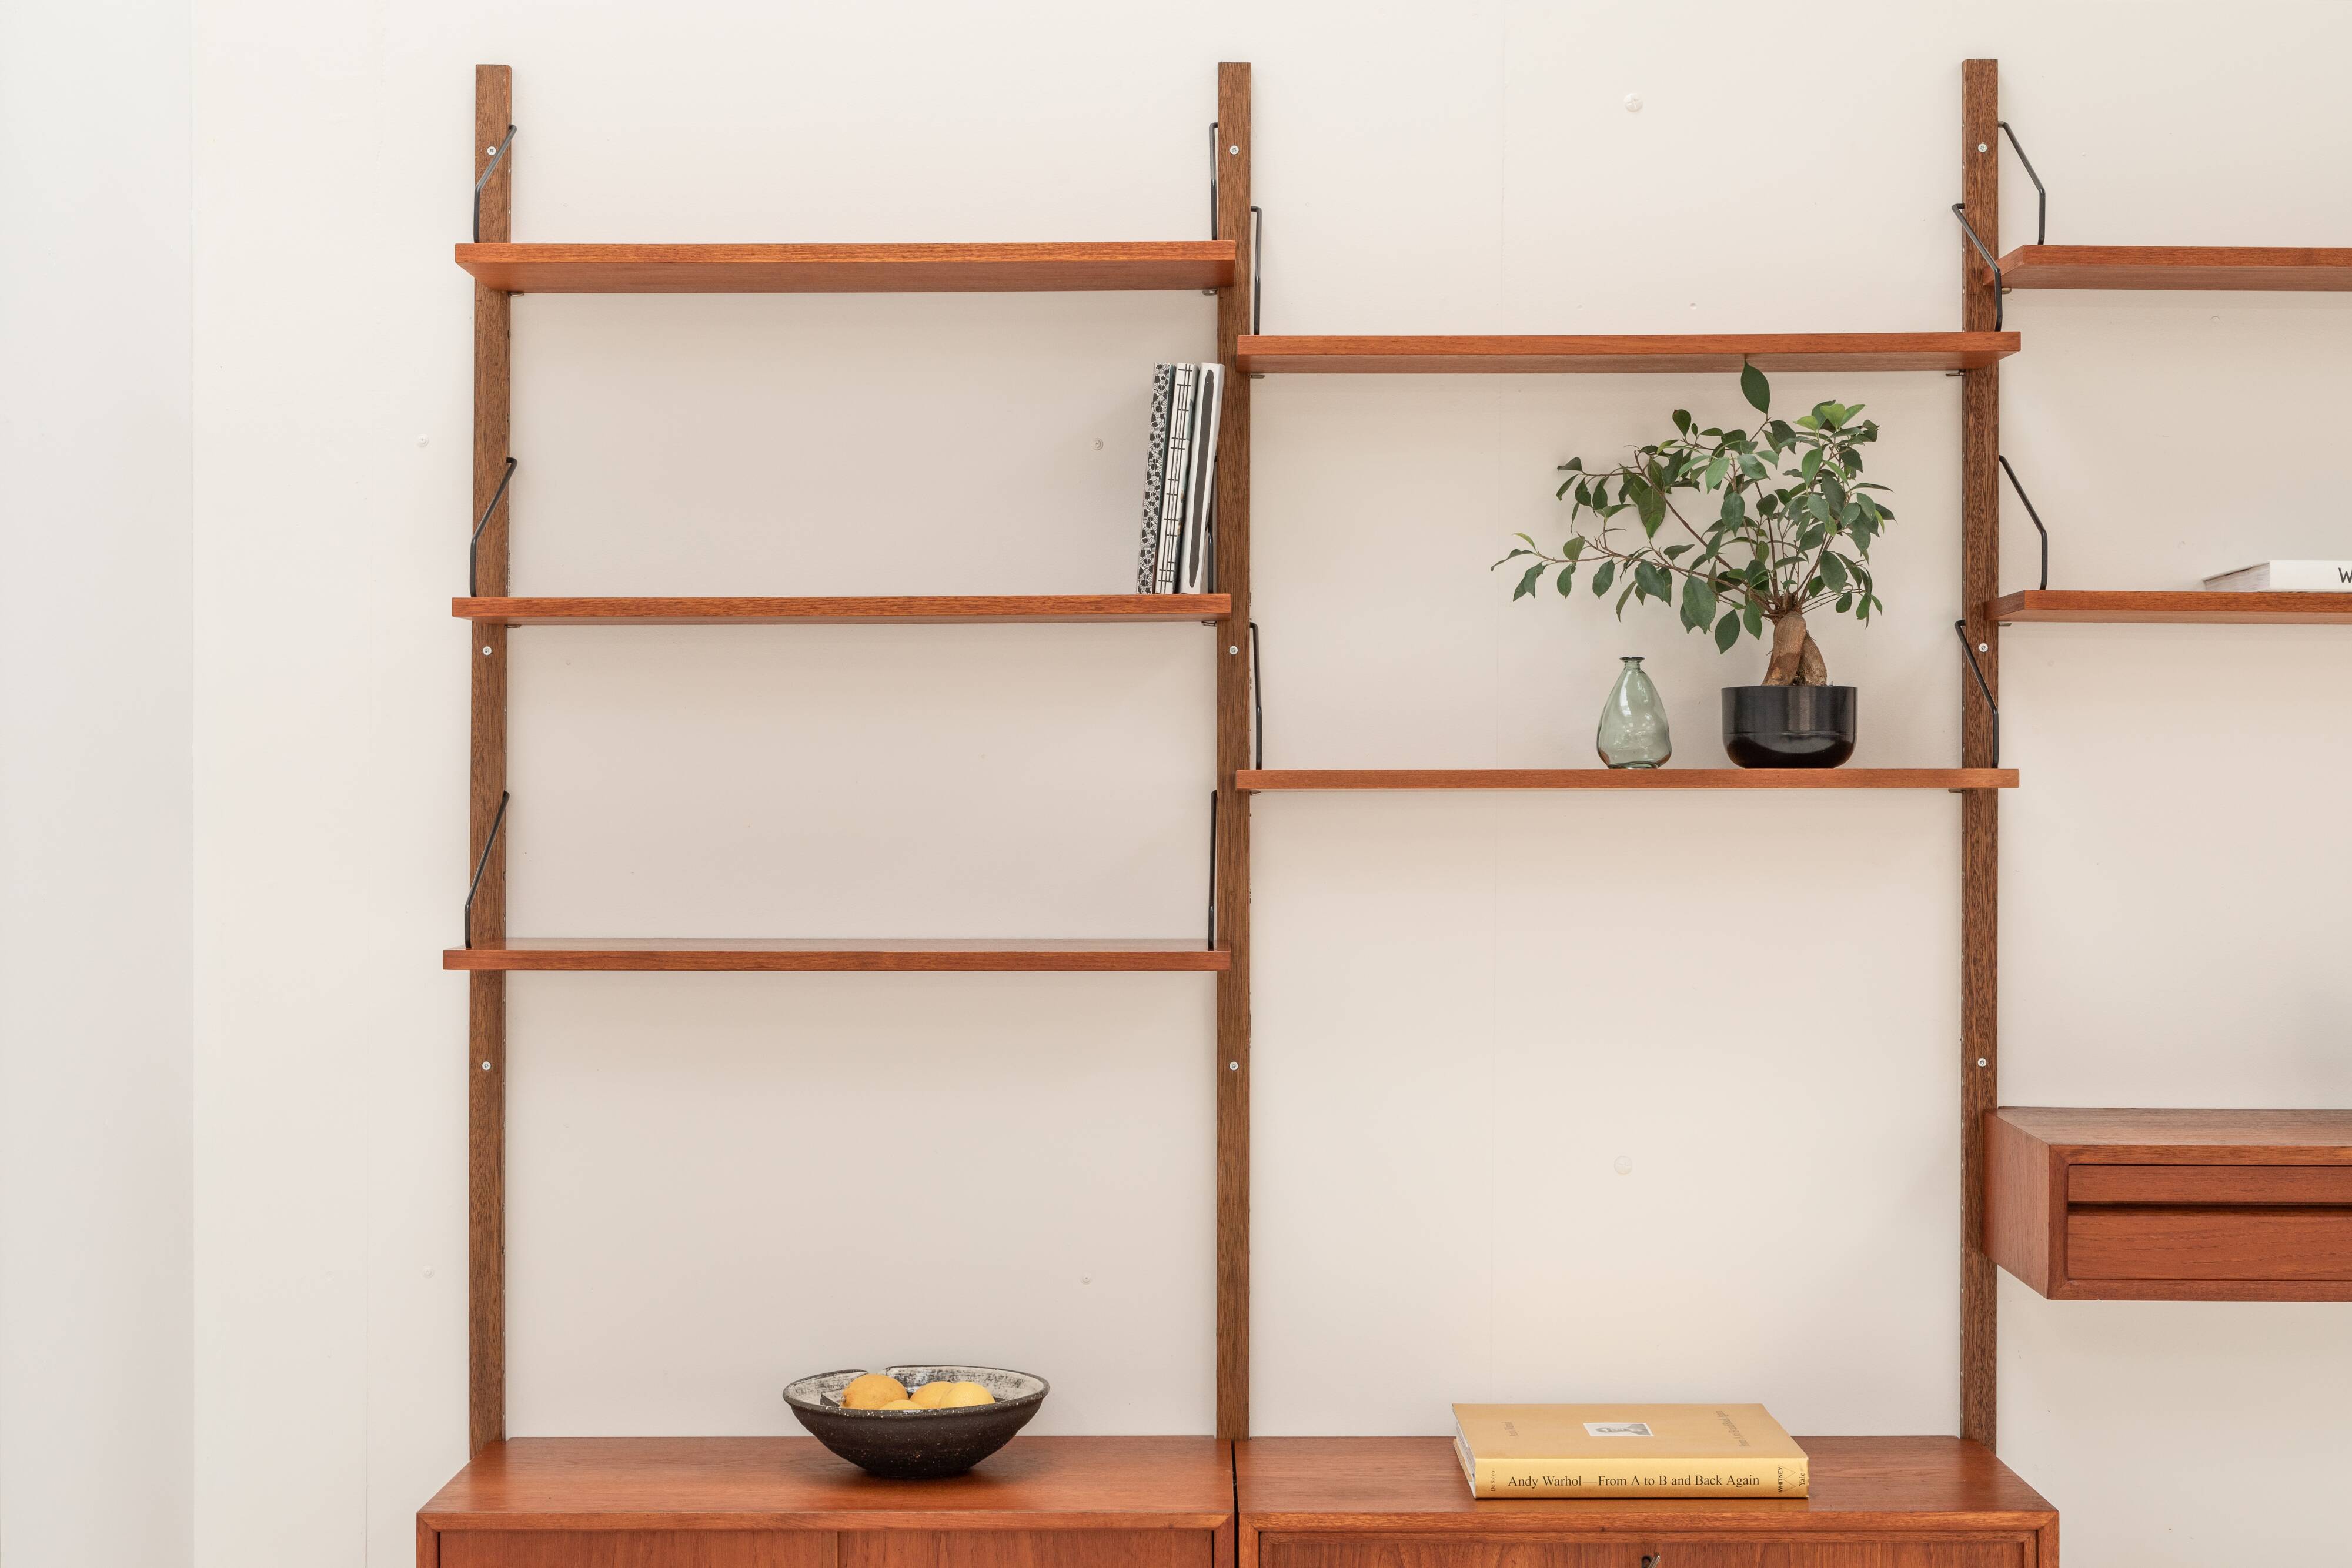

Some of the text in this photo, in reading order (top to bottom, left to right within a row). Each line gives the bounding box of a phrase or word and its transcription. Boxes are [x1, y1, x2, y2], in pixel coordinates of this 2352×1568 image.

[1508, 1476, 1539, 1489] Andy
[1631, 1475, 1641, 1486] A
[1644, 1476, 1655, 1486] to
[1659, 1475, 1668, 1486] B
[1671, 1475, 1691, 1486] and
[1695, 1475, 1723, 1486] Back
[1726, 1475, 1760, 1488] Again
